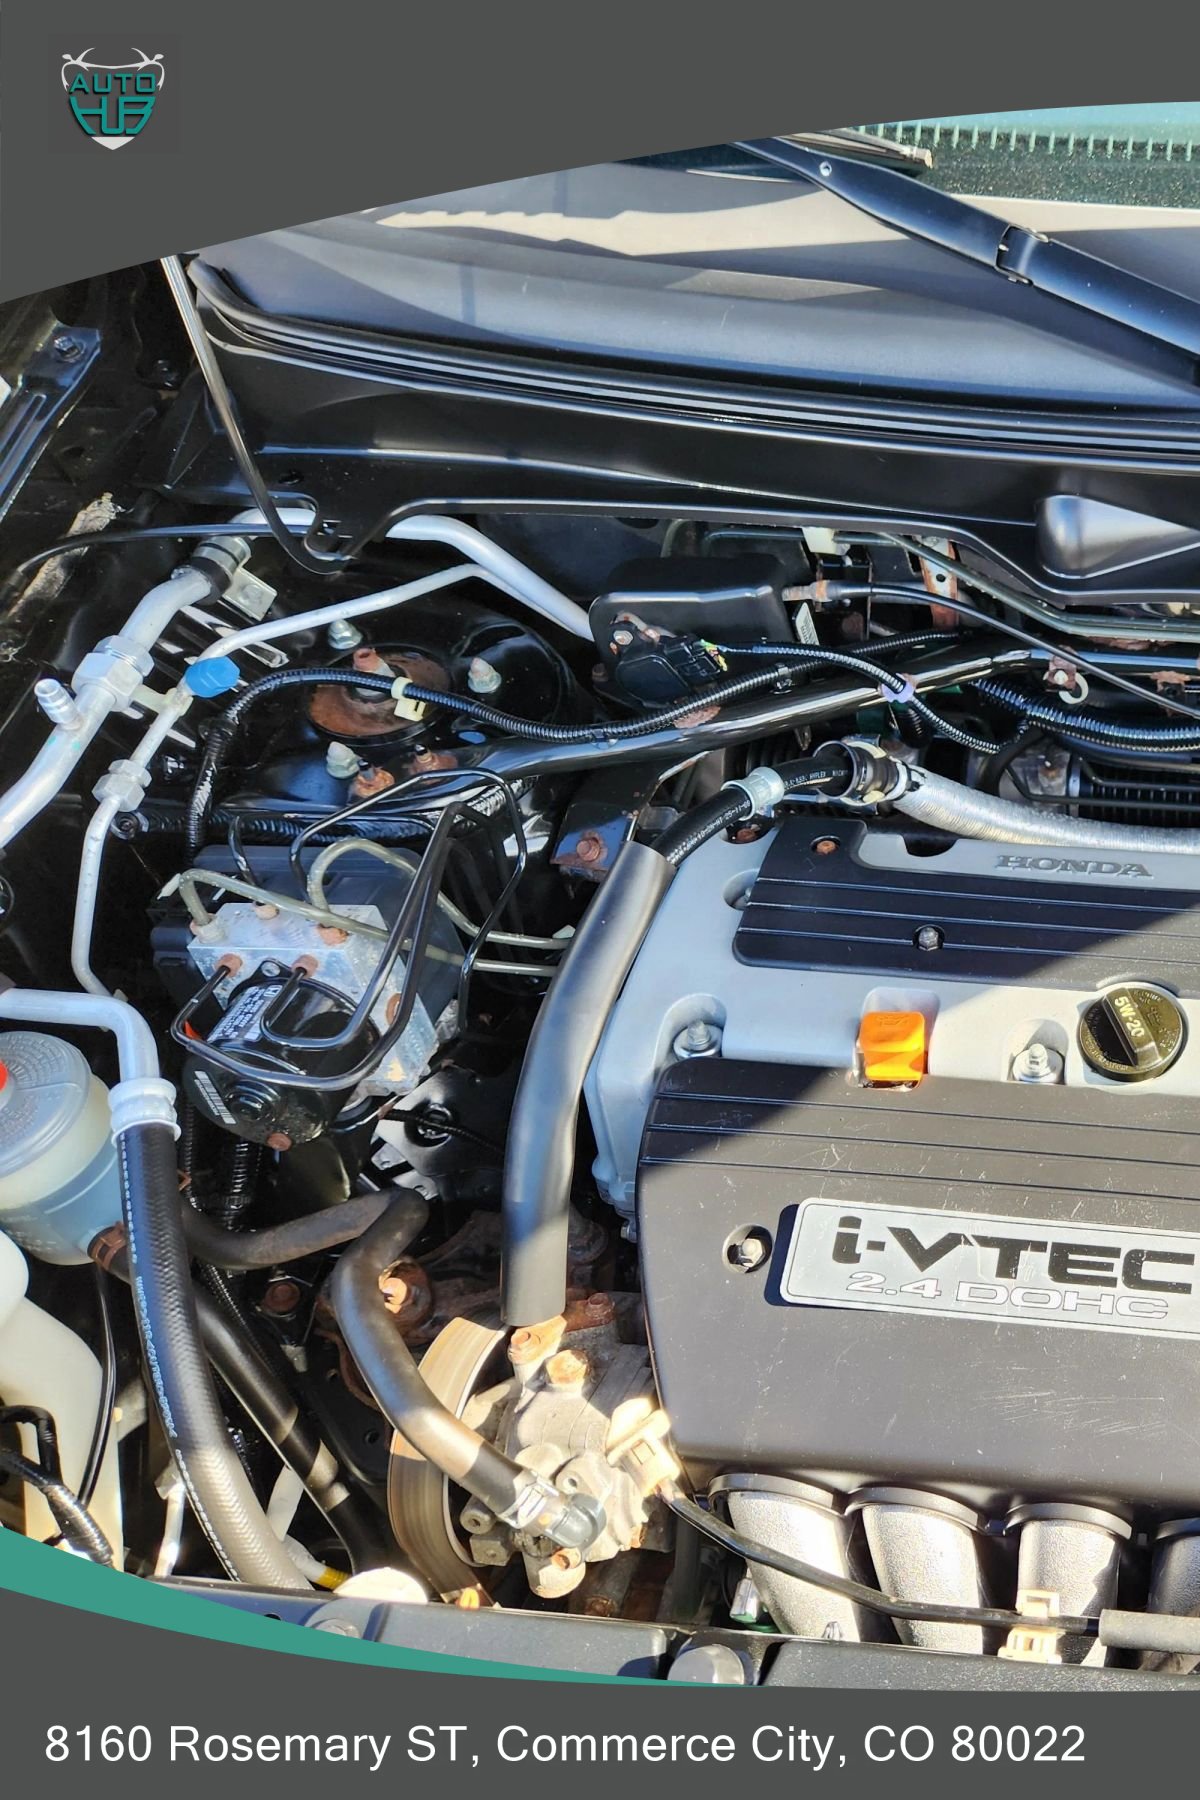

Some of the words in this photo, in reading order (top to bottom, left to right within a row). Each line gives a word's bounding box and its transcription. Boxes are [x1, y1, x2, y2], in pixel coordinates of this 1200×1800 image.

[994, 855, 1155, 880] HONDA
[1114, 996, 1146, 1038] 5W-20
[831, 1215, 1196, 1295] i-VTEC
[845, 1271, 942, 1300] 2.4
[955, 1281, 1170, 1320] DOHC
